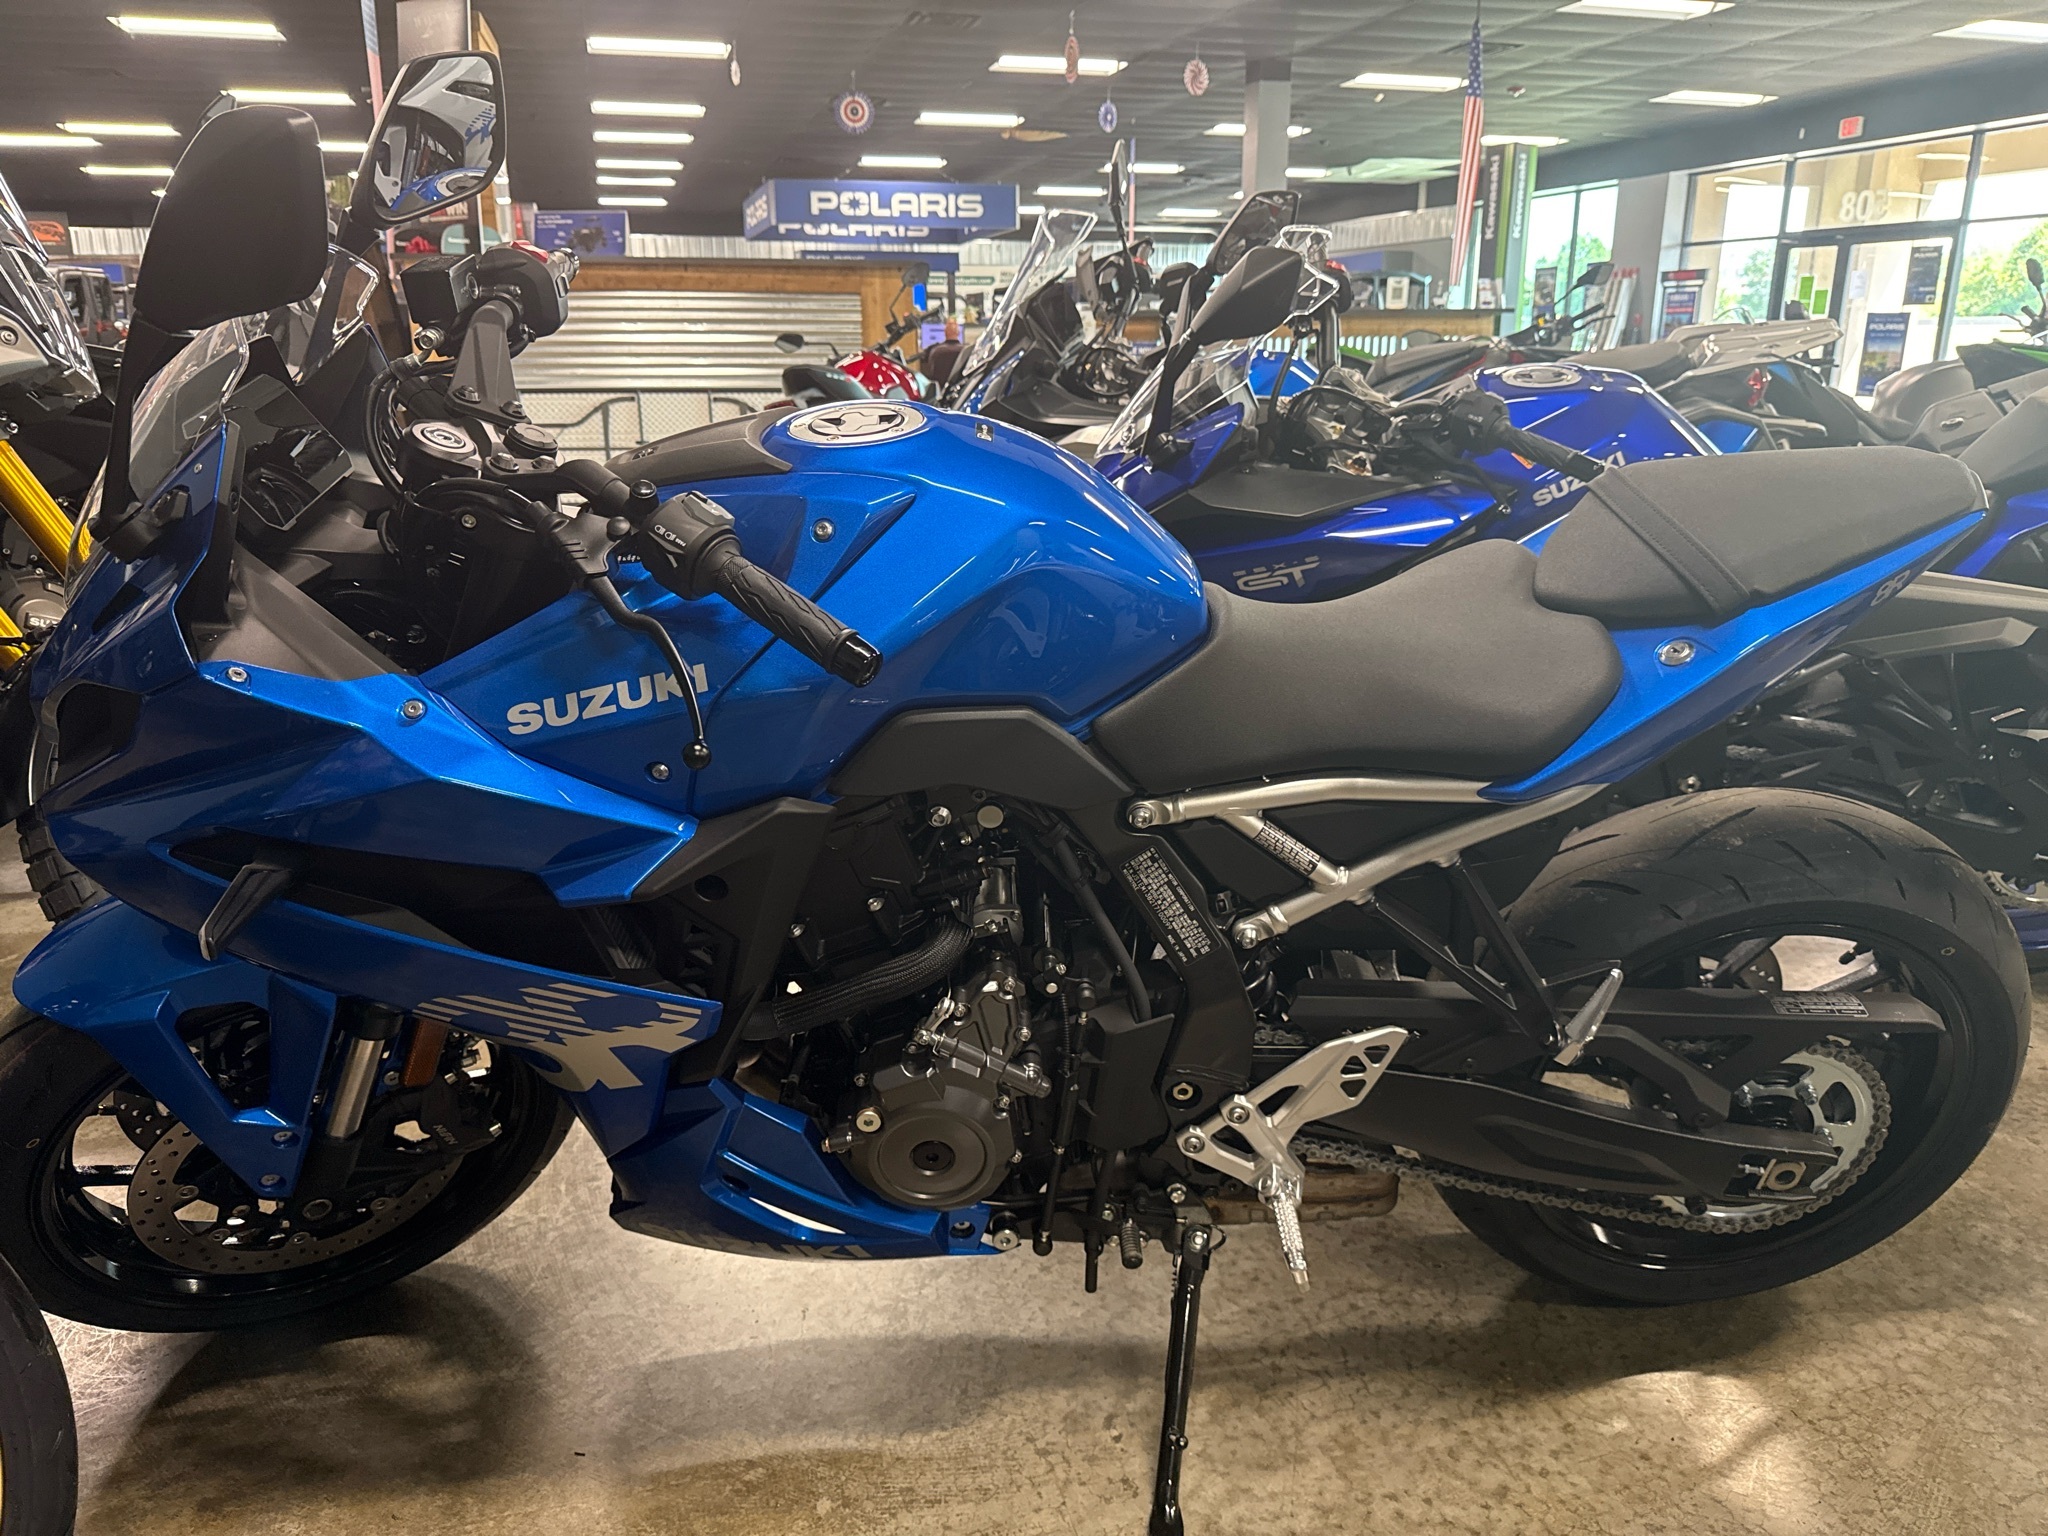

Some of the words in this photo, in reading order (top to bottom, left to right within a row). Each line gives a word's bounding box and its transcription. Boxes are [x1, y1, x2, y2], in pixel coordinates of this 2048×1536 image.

[809, 190, 984, 218] POLARIS
[1484, 155, 1500, 239] Kawasaki
[1512, 153, 1527, 238] Kawasaki
[506, 663, 709, 735] SUZUKI
